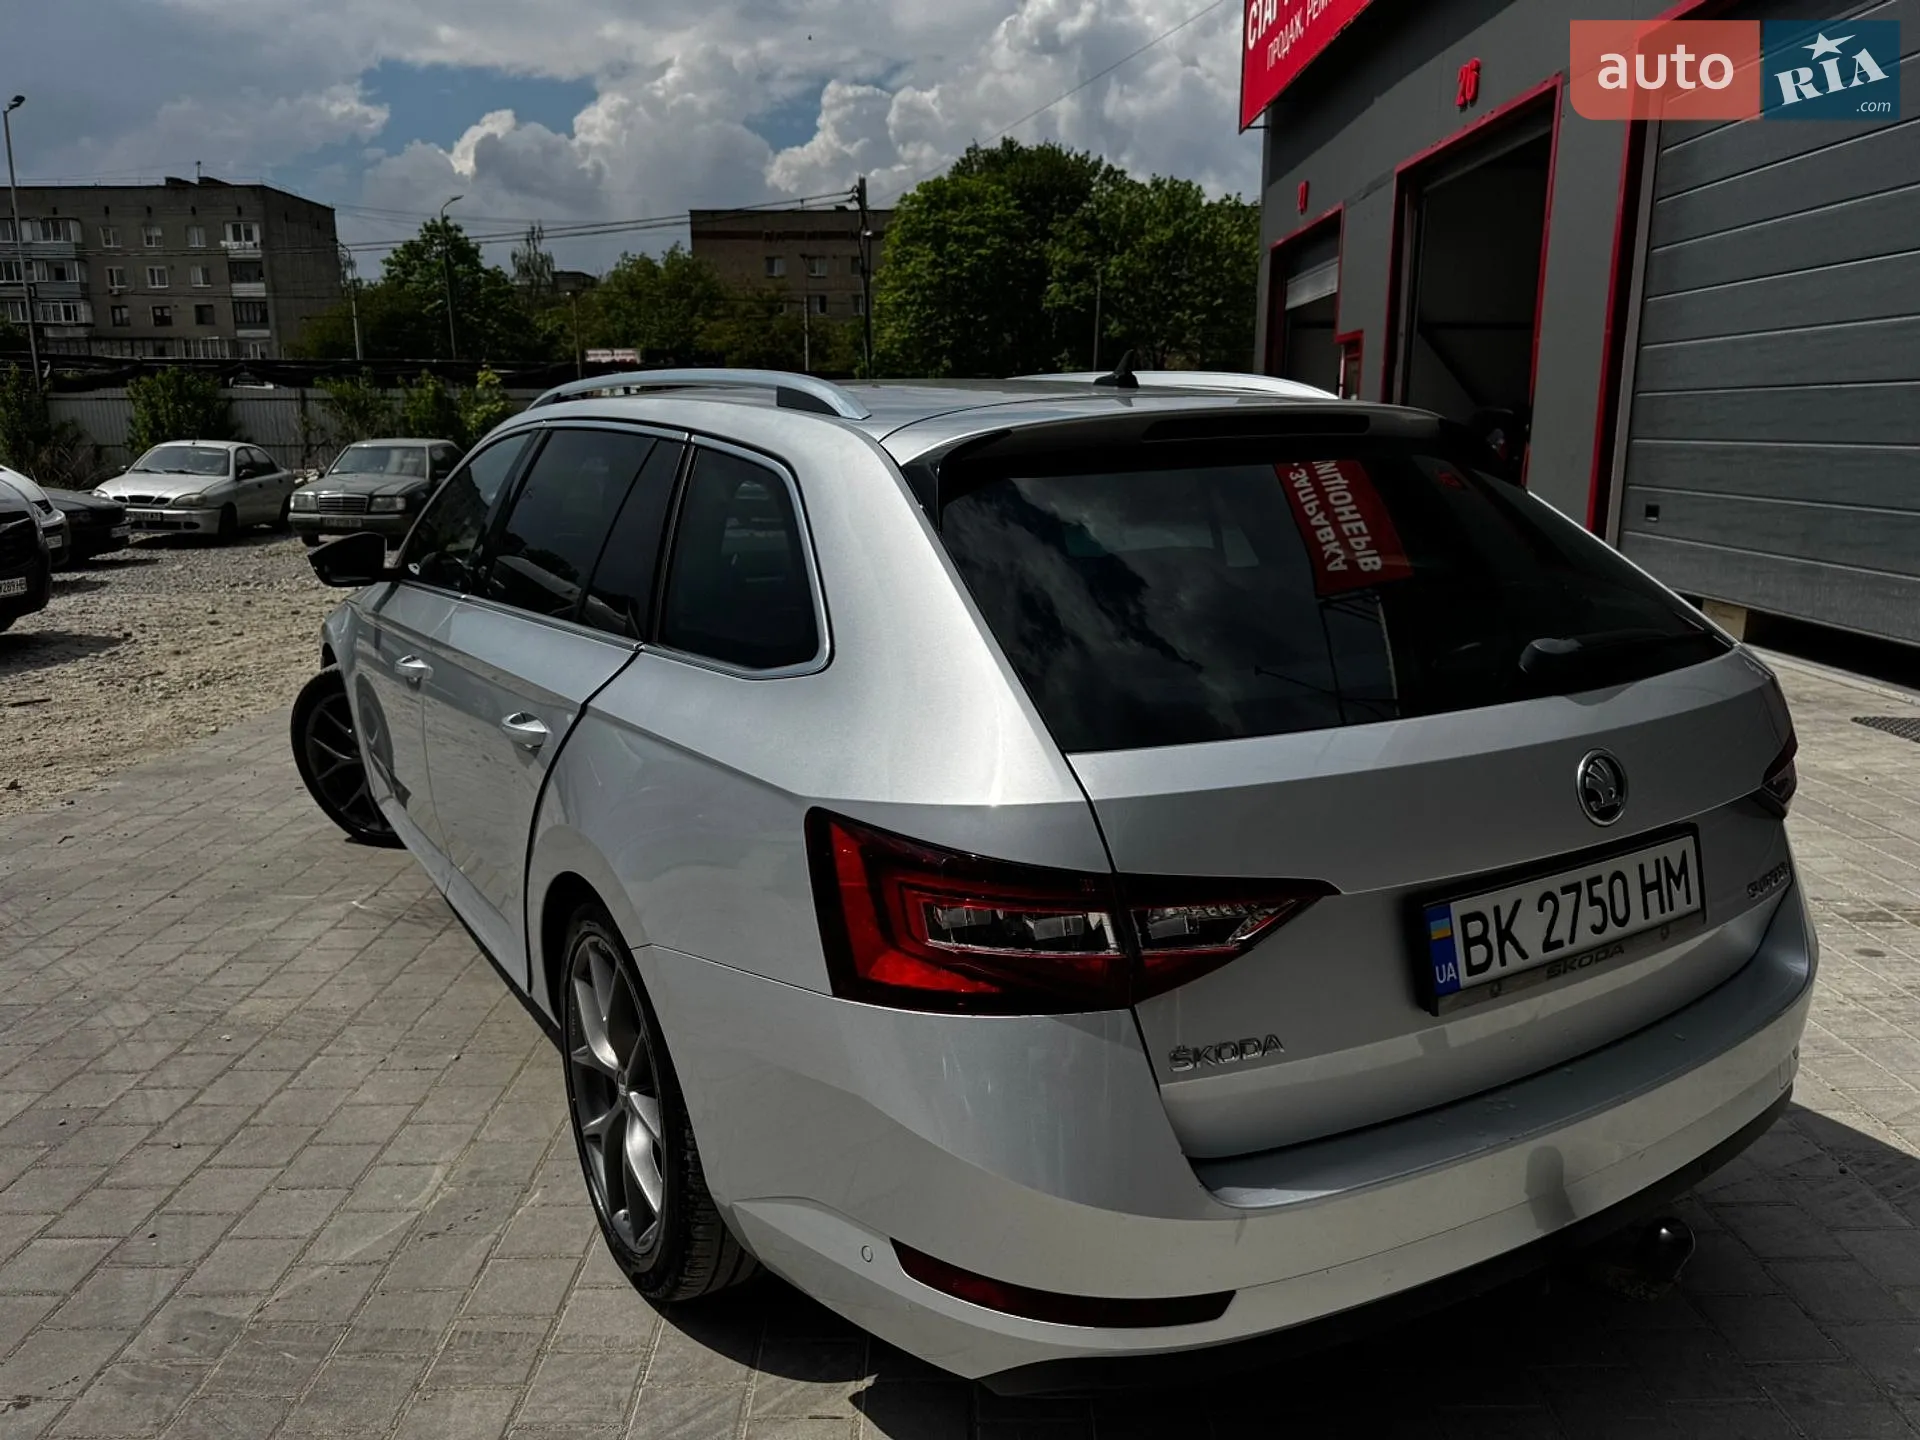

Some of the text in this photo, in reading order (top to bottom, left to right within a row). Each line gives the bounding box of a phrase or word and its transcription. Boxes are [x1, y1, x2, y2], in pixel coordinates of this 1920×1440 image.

[1248, 0, 1288, 51] СТА
[1460, 850, 1692, 977] BK 2750 HM
[1435, 963, 1458, 984] UA
